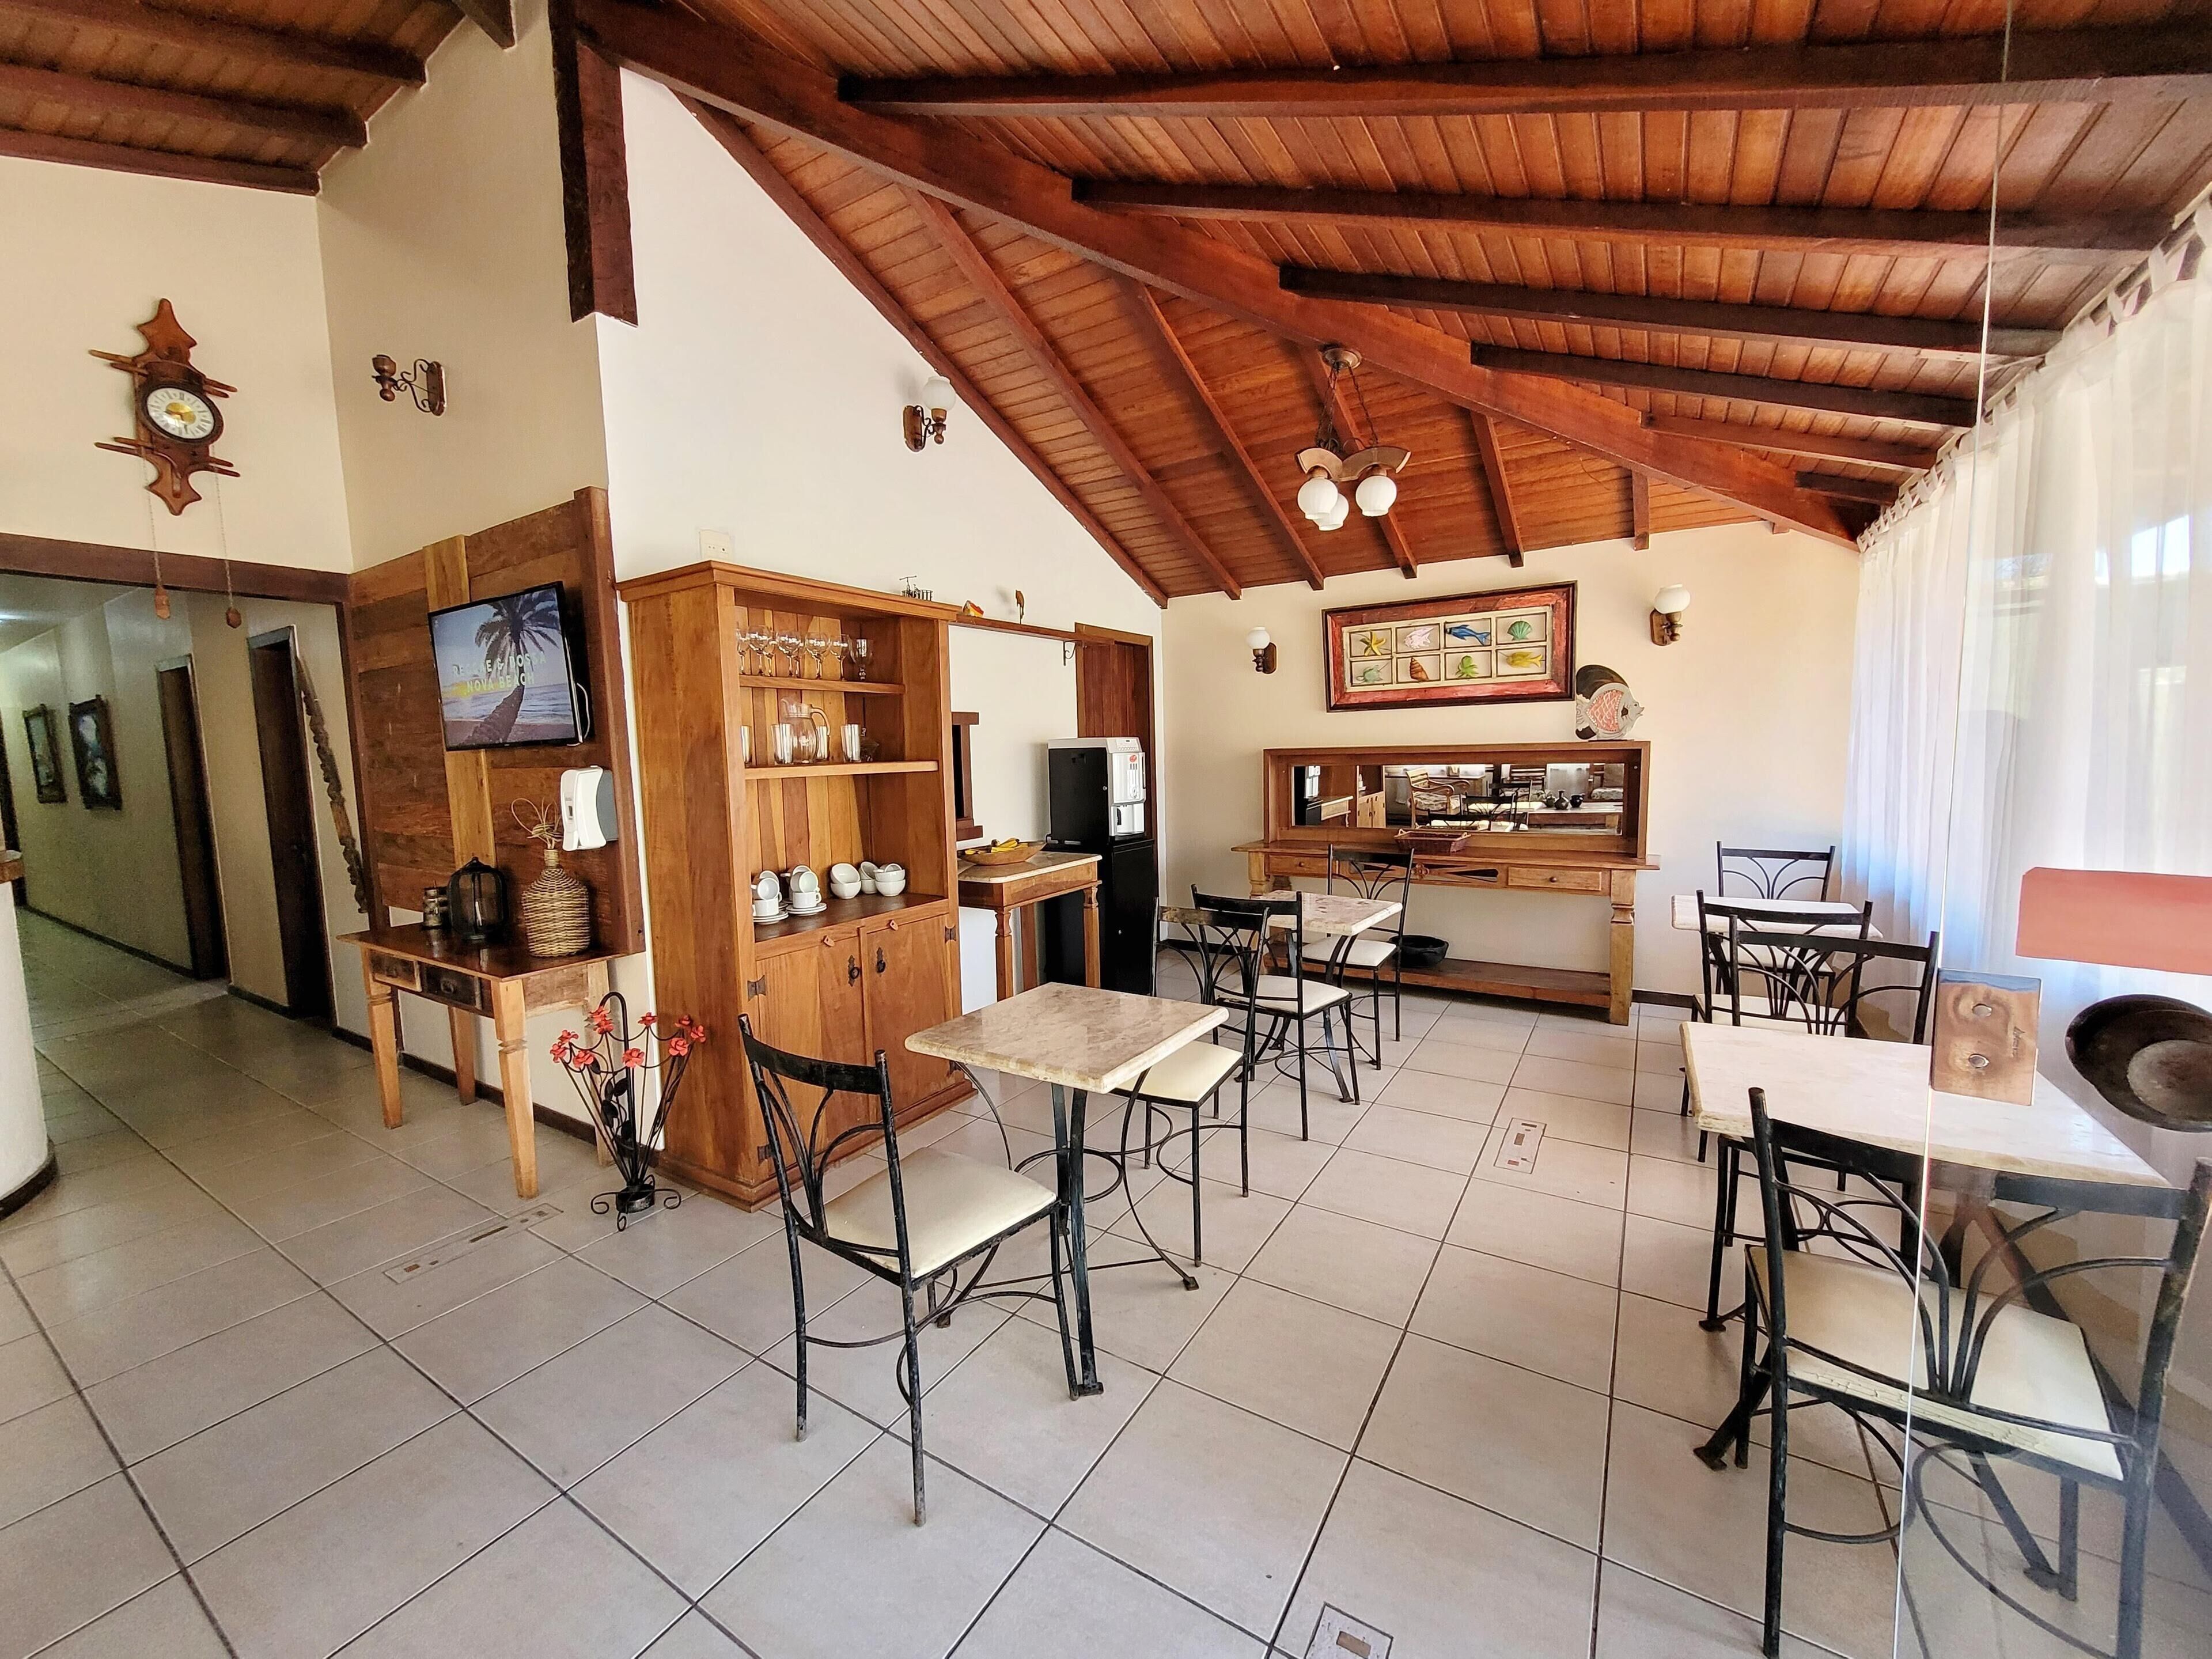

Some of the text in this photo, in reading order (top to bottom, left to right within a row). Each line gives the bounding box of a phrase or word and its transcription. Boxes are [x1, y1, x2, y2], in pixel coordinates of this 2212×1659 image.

[453, 660, 492, 677] REE
[467, 672, 535, 692] NOVA BEACH
